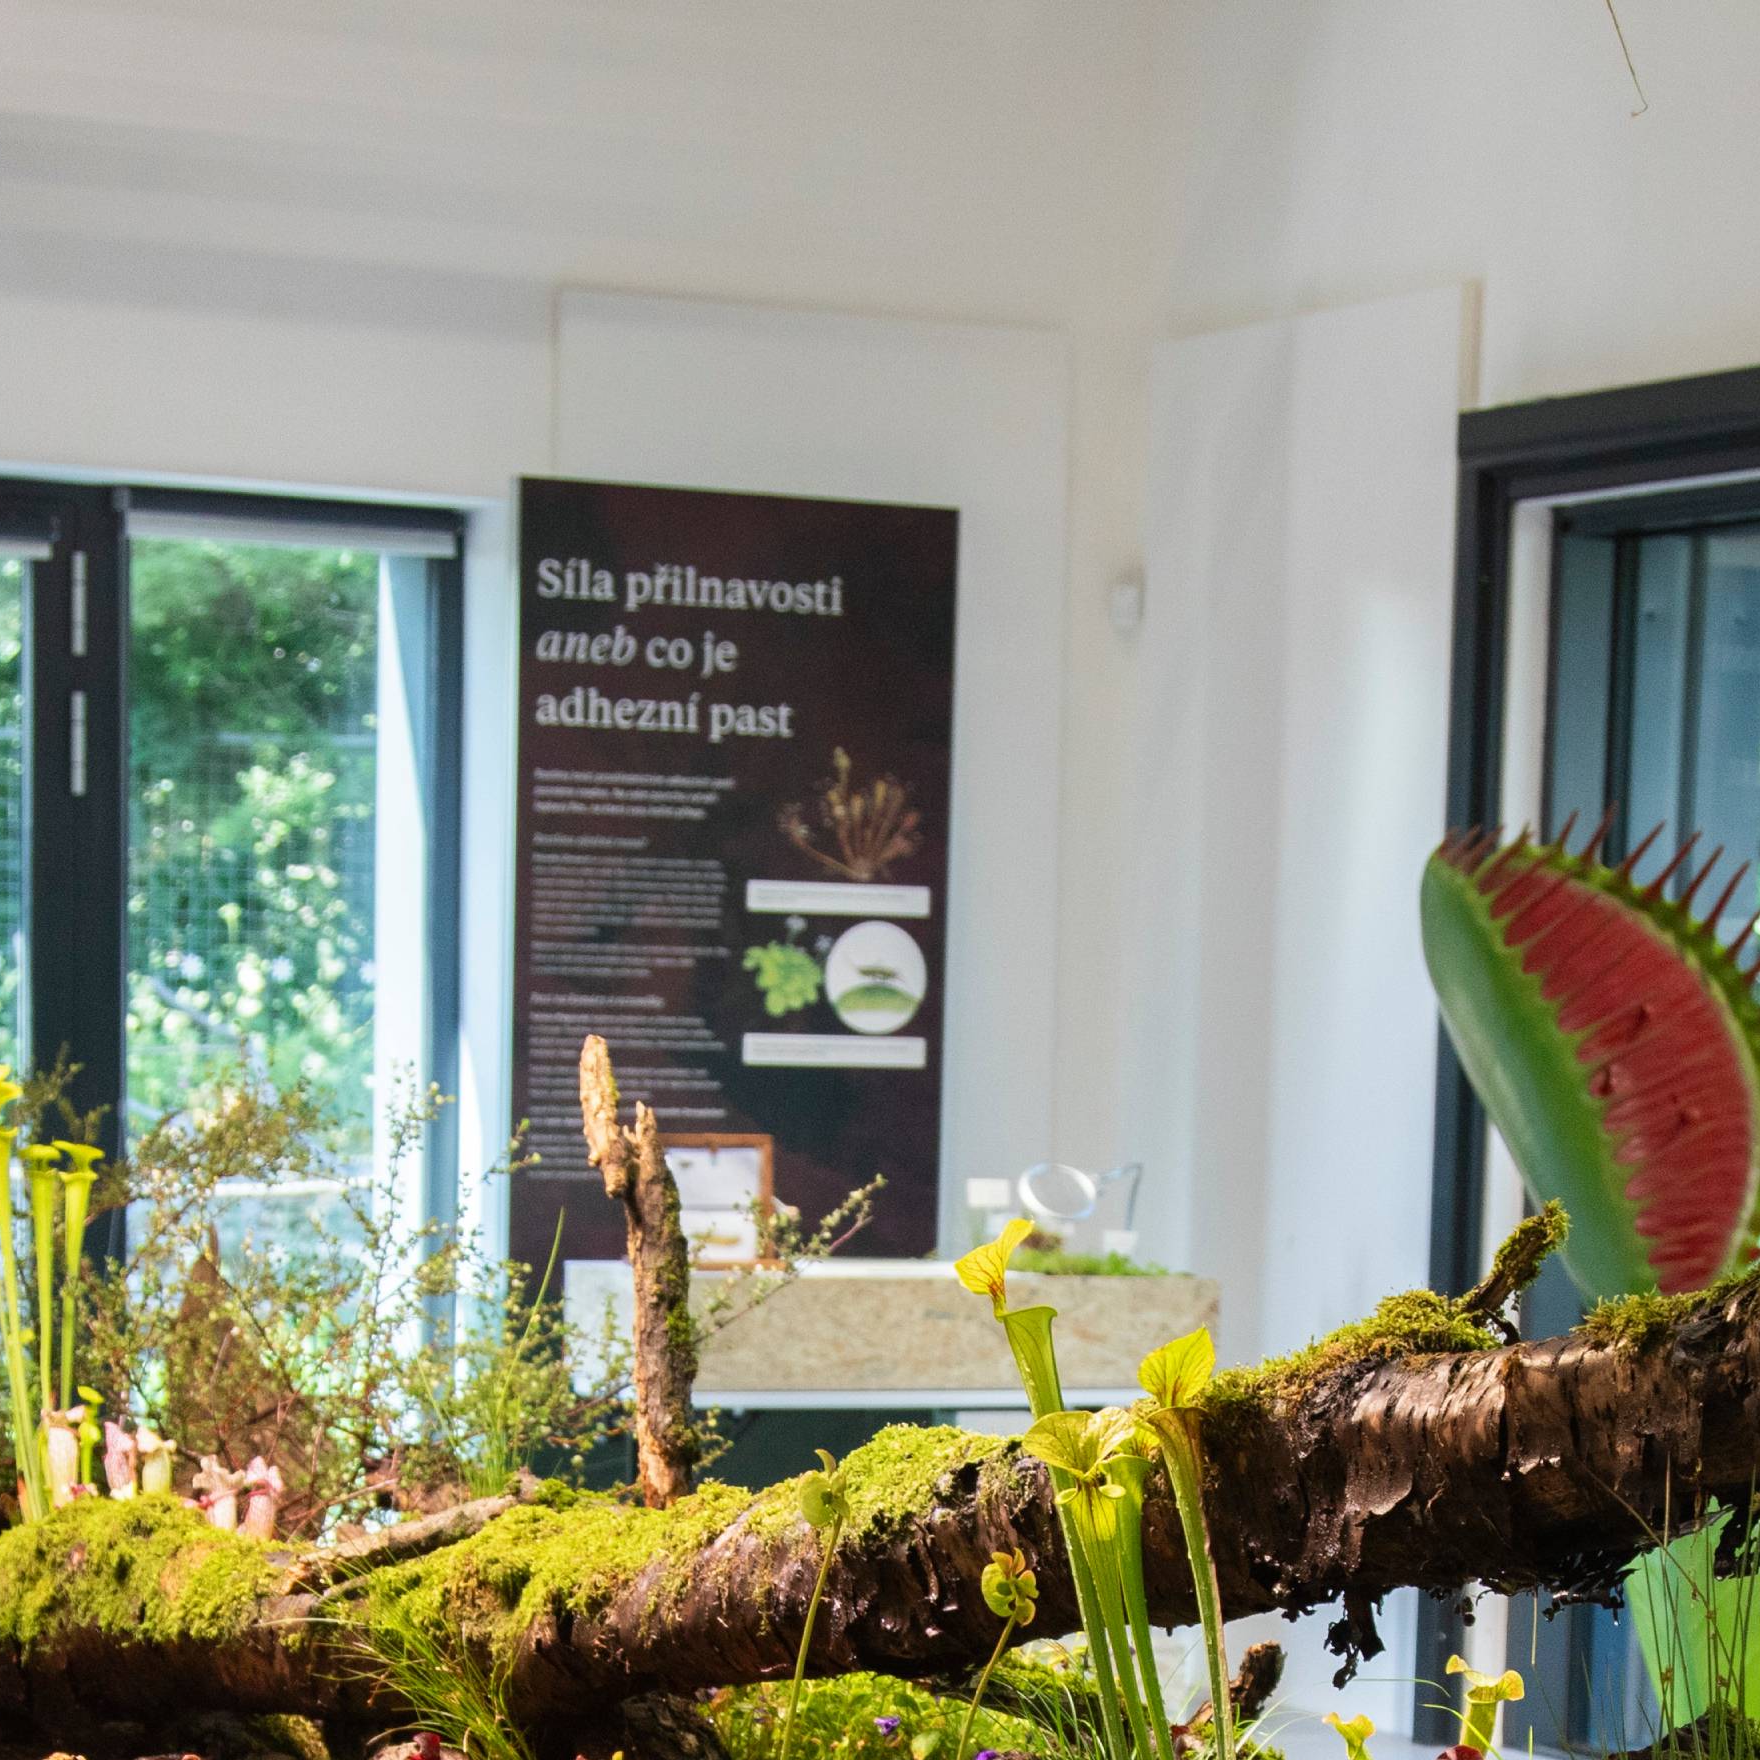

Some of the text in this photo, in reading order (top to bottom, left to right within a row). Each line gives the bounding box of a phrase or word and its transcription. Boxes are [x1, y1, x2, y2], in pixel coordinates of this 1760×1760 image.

[536, 557, 844, 616] Síla přilnavosti
[535, 624, 739, 678] aneb co je
[535, 685, 794, 744] adhezní past
